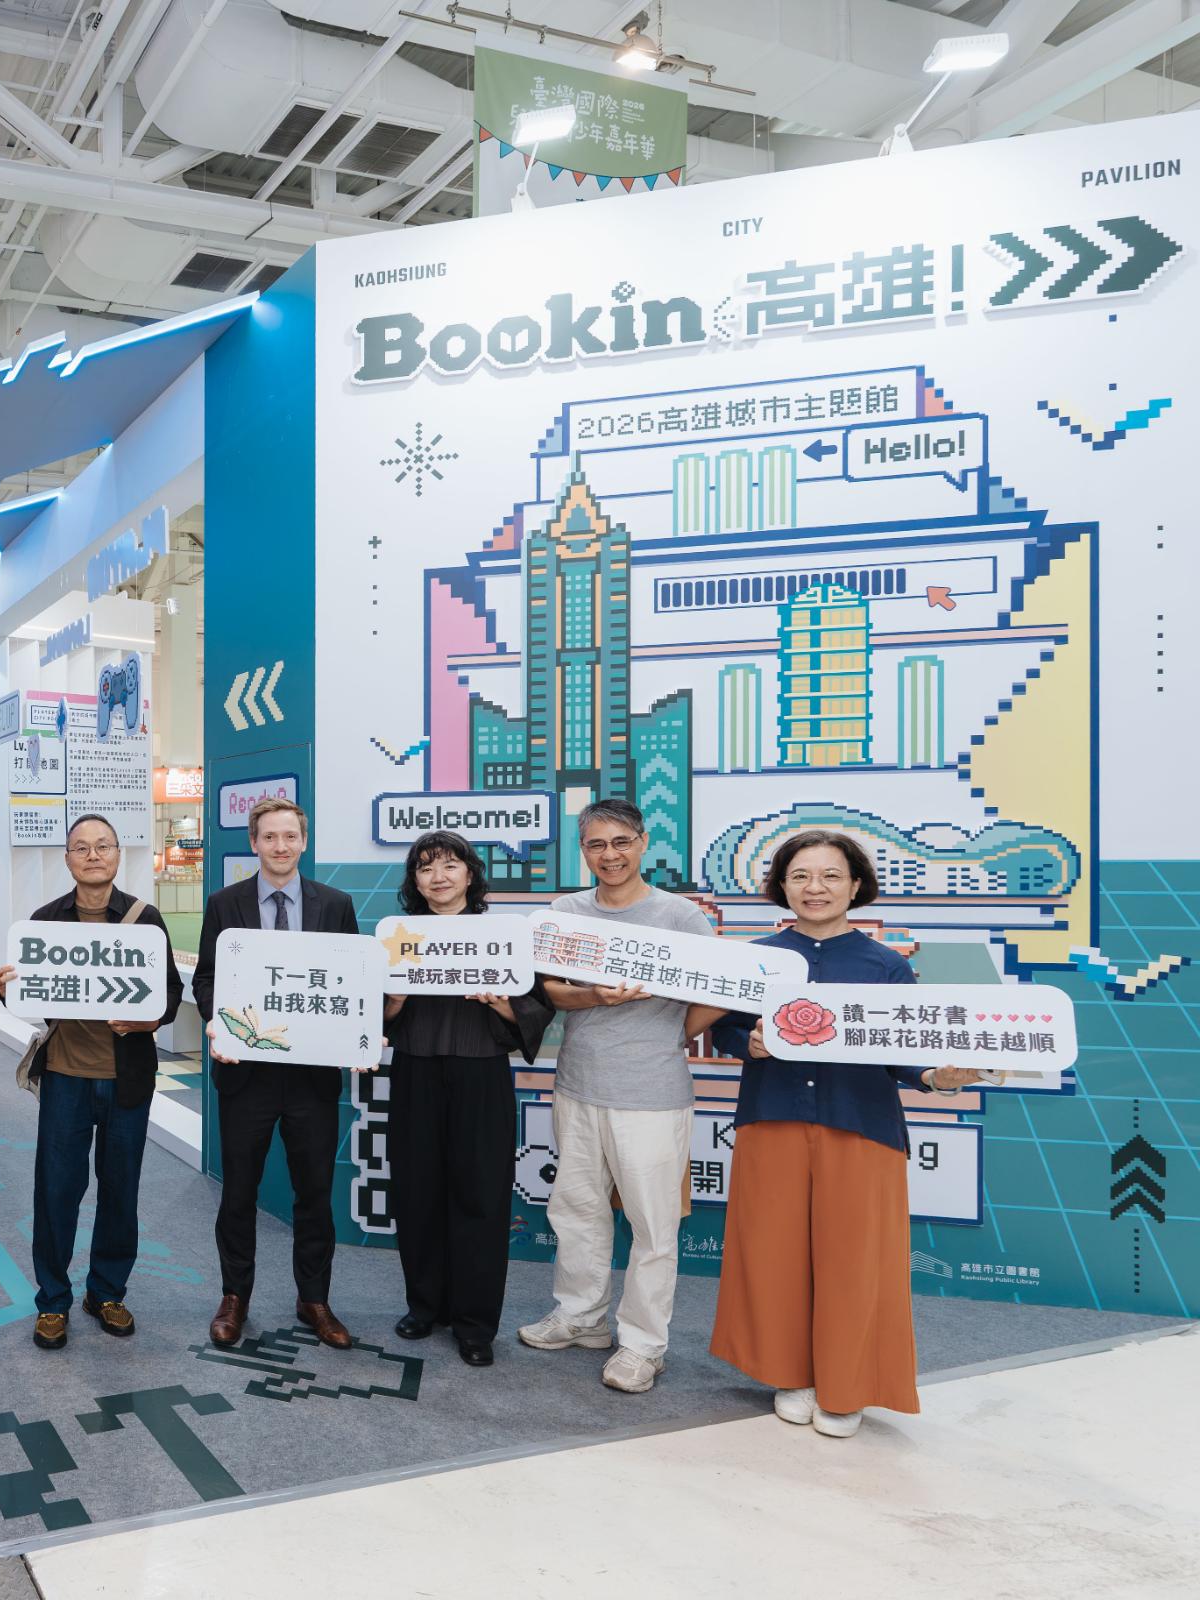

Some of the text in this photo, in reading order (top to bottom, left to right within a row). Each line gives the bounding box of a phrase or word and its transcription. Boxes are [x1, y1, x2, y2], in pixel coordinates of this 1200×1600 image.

[1081, 159, 1182, 188] PAVILION
[721, 216, 764, 238] CITY
[354, 262, 447, 288] KAOHSIUNG
[354, 281, 706, 383] Bookin
[577, 384, 899, 439] 2026高雄城市主題館
[864, 430, 966, 464] Hello!
[388, 803, 541, 829] Welcome!
[18, 938, 147, 967] Bookin
[400, 942, 514, 956] PLAYER 01
[609, 937, 672, 961] 2026
[389, 967, 519, 986] 一號玩家已登入
[842, 1004, 968, 1026] 讀一本好書
[843, 1028, 1057, 1054] 腳踩花路越走越順
[960, 1263, 1040, 1278] 高雄市立圖書館
[960, 1274, 994, 1282] Kaohsiung
[1016, 1278, 1040, 1286] Library
